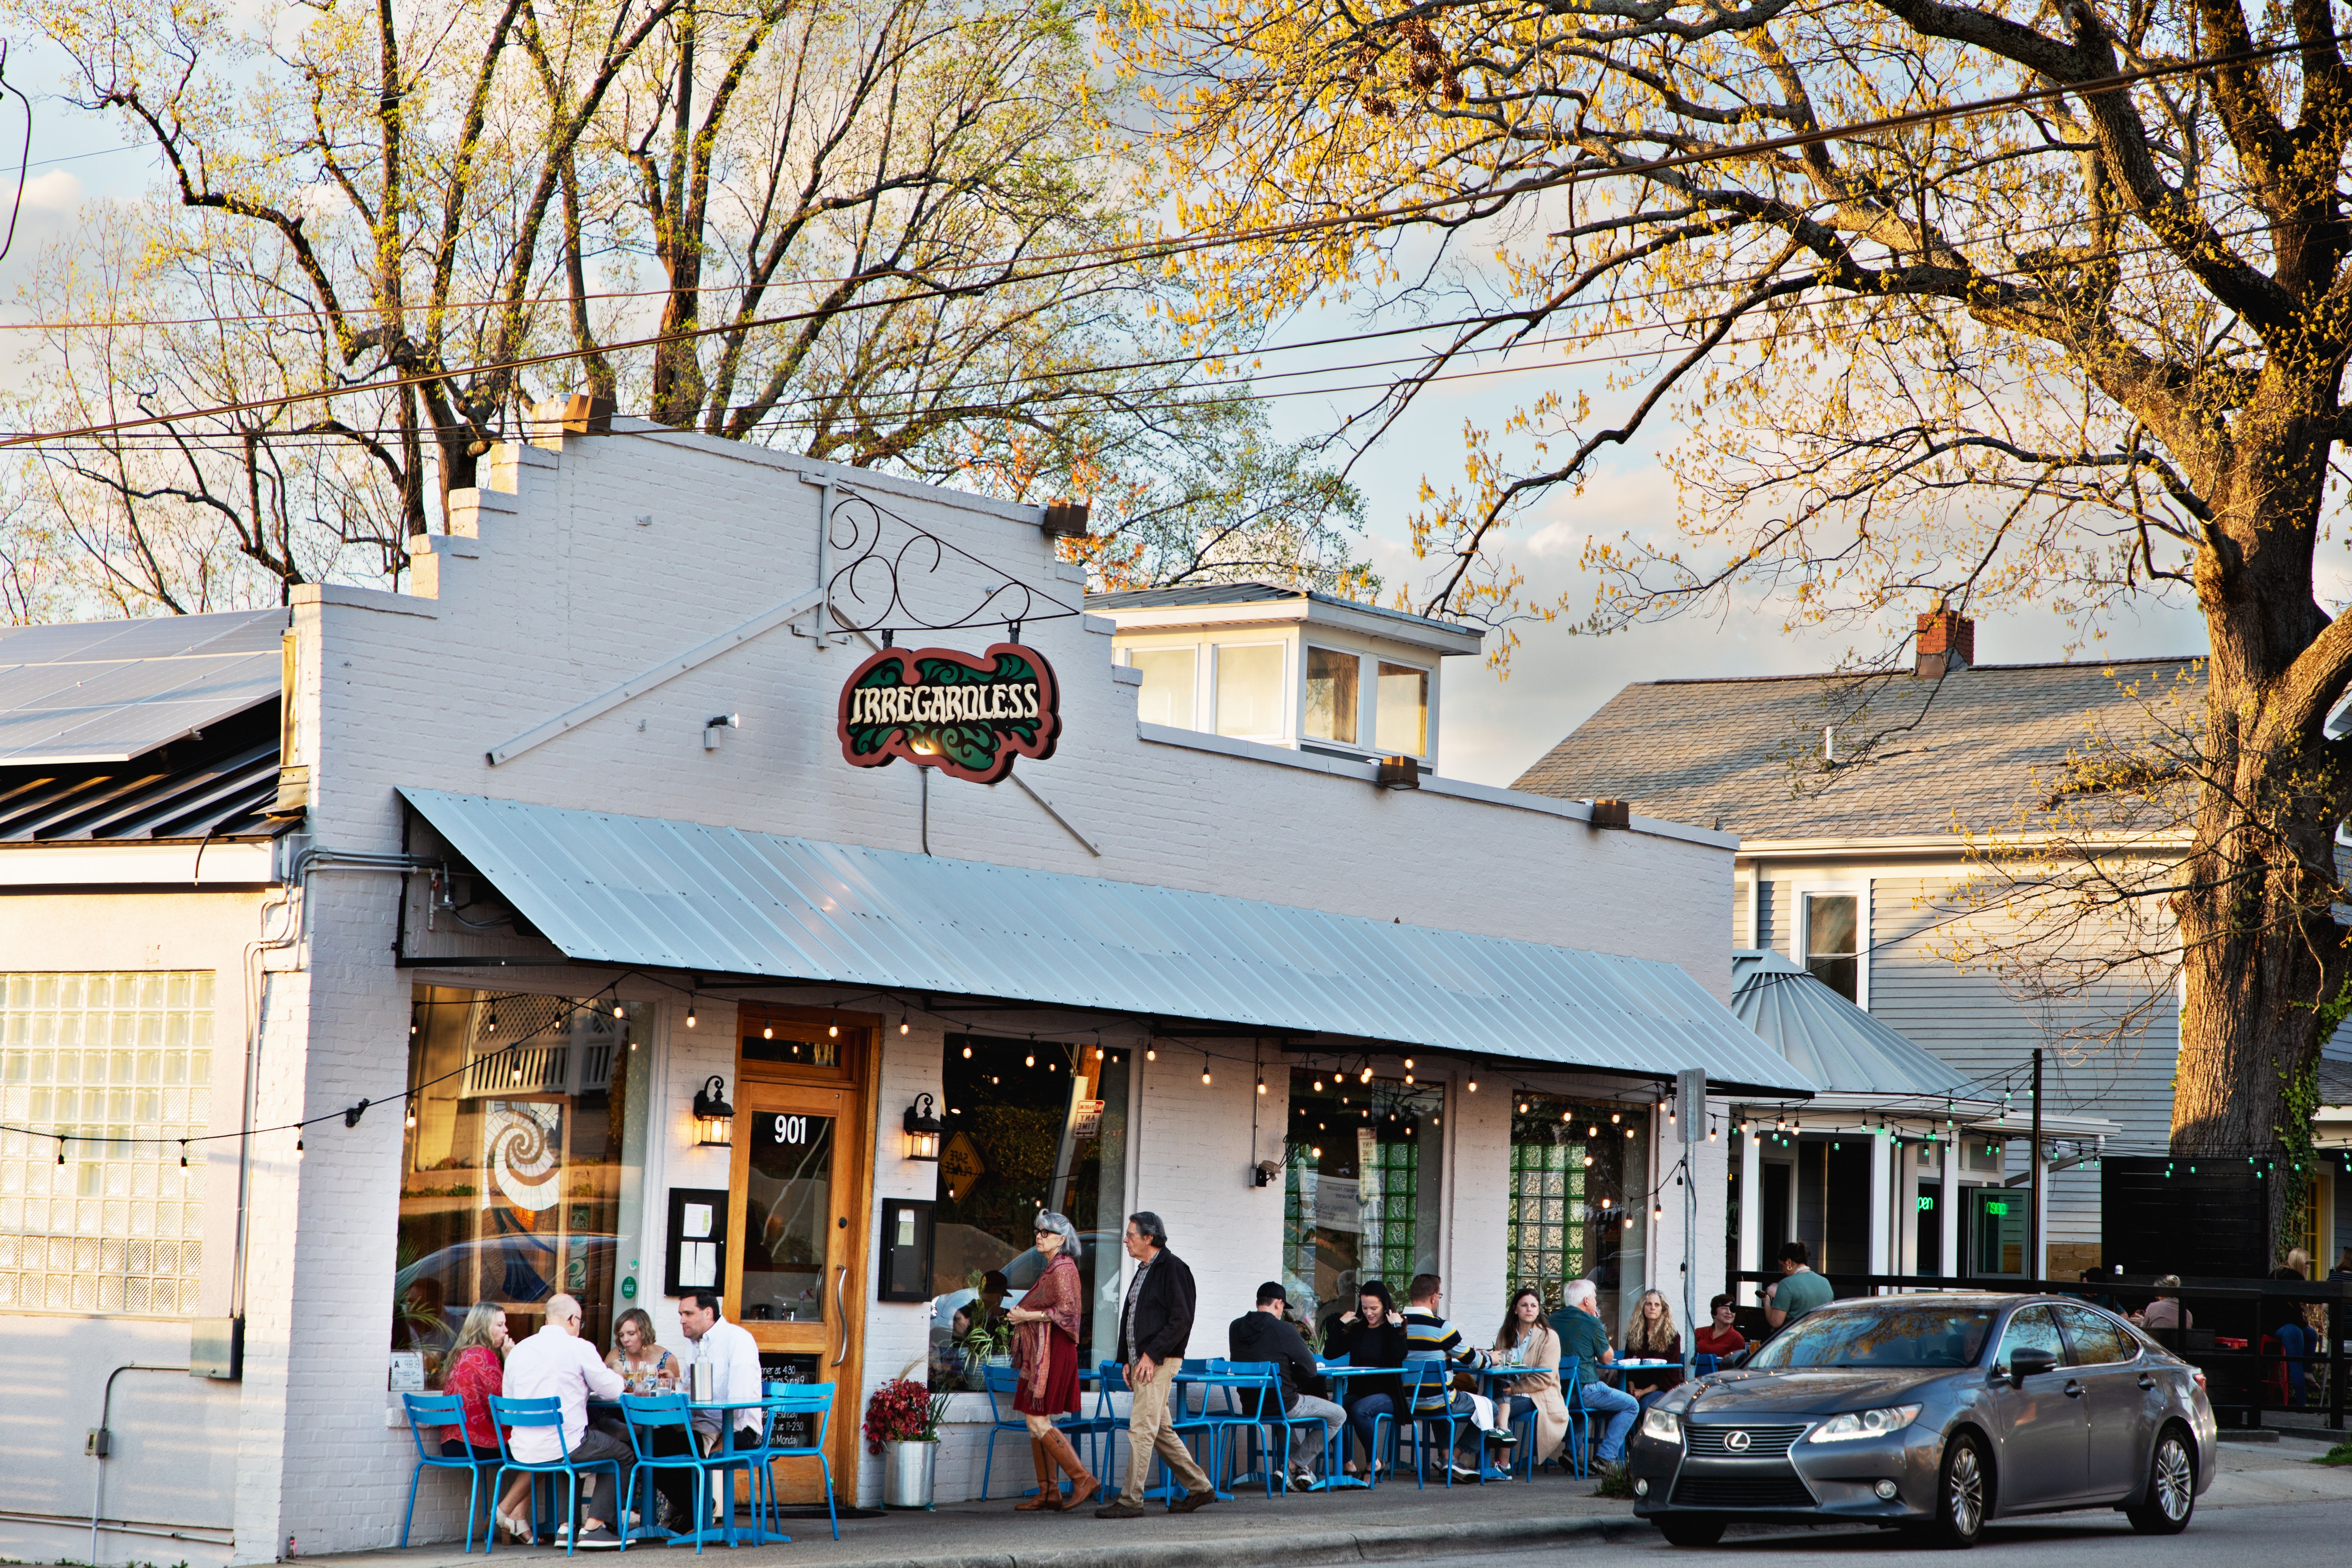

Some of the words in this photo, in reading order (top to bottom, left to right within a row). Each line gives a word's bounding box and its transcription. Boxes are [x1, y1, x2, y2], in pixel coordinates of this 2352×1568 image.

[850, 684, 1038, 724] IRREGARDLESS
[775, 1115, 806, 1144] 901
[1917, 1197, 1933, 1213] pen
[775, 1366, 781, 1375] at
[800, 1375, 805, 1384] 9
[777, 1434, 799, 1447] Monday
